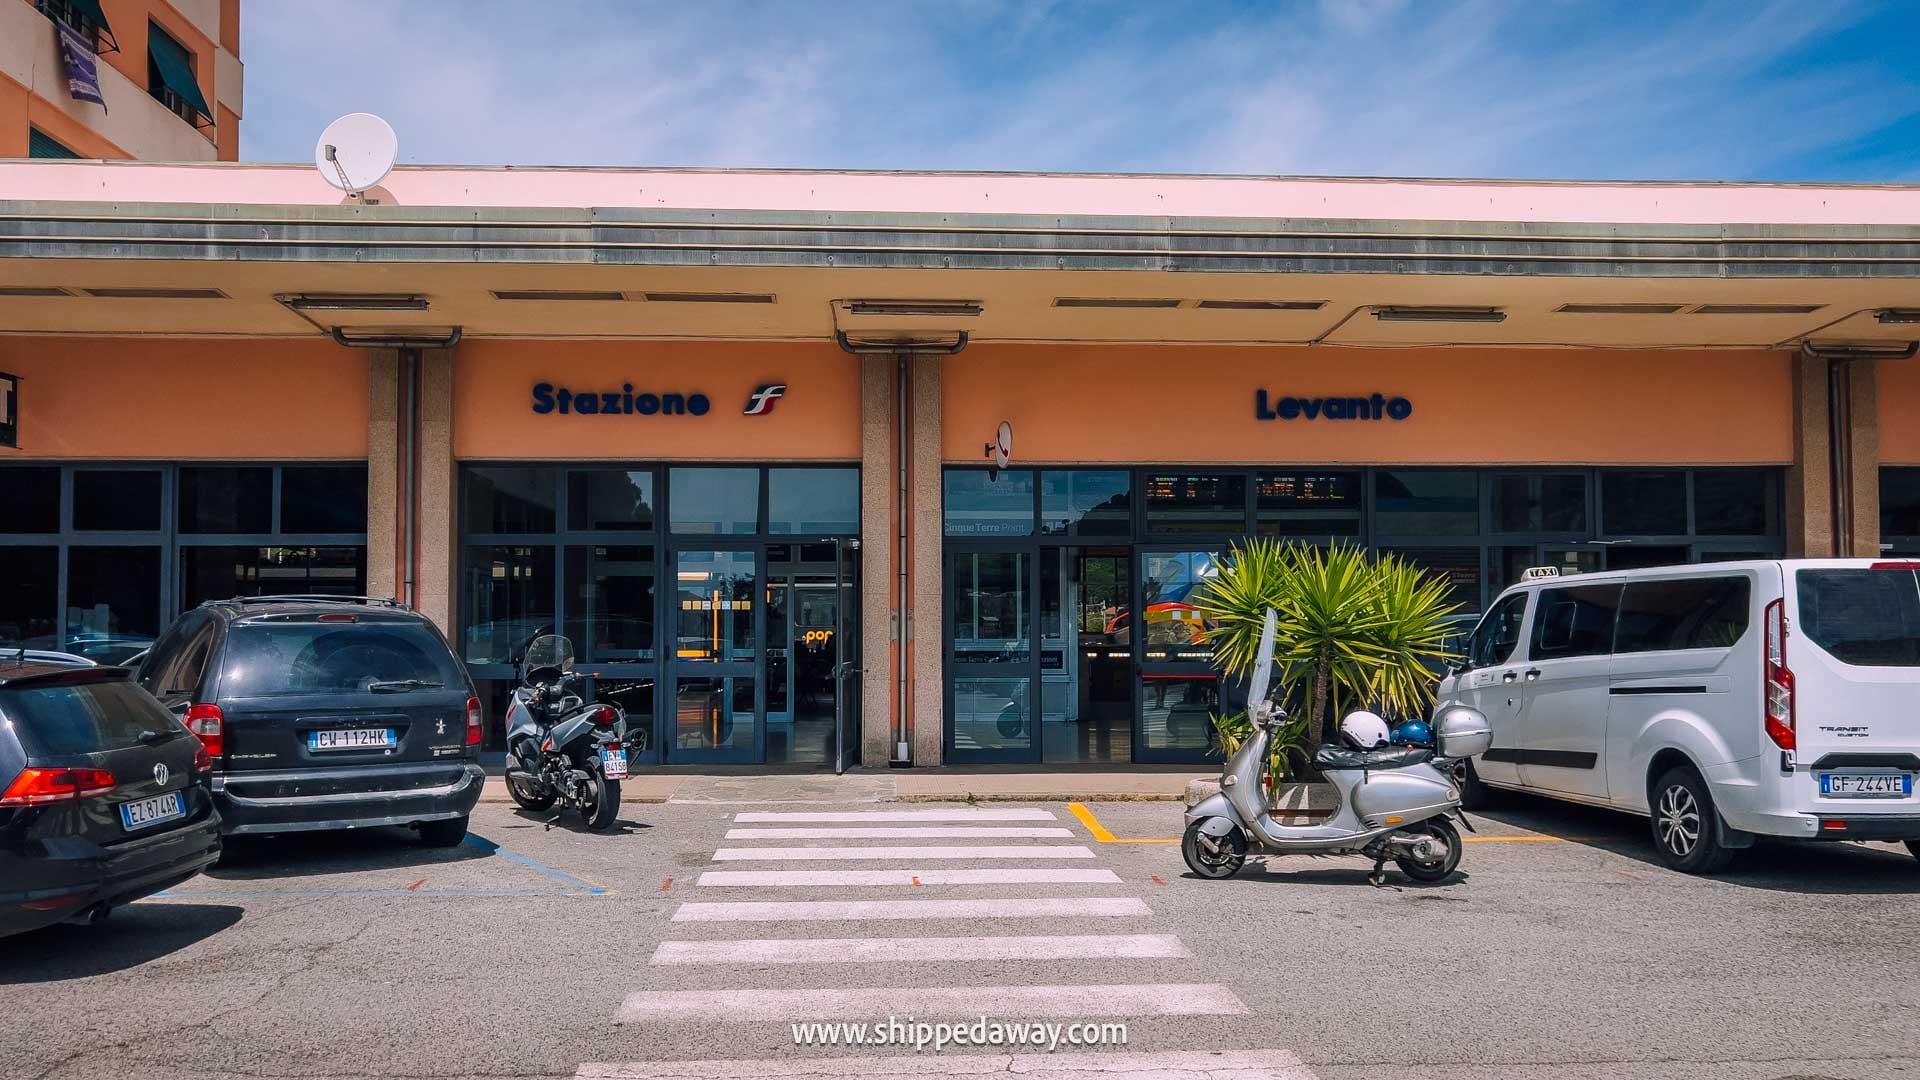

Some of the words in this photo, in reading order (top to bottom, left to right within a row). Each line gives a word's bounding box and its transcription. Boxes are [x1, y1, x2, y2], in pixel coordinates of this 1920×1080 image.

[532, 382, 710, 415] Stazione
[1256, 389, 1412, 420] Levanto
[975, 522, 1000, 533] Terre
[1530, 568, 1556, 577] TAXI
